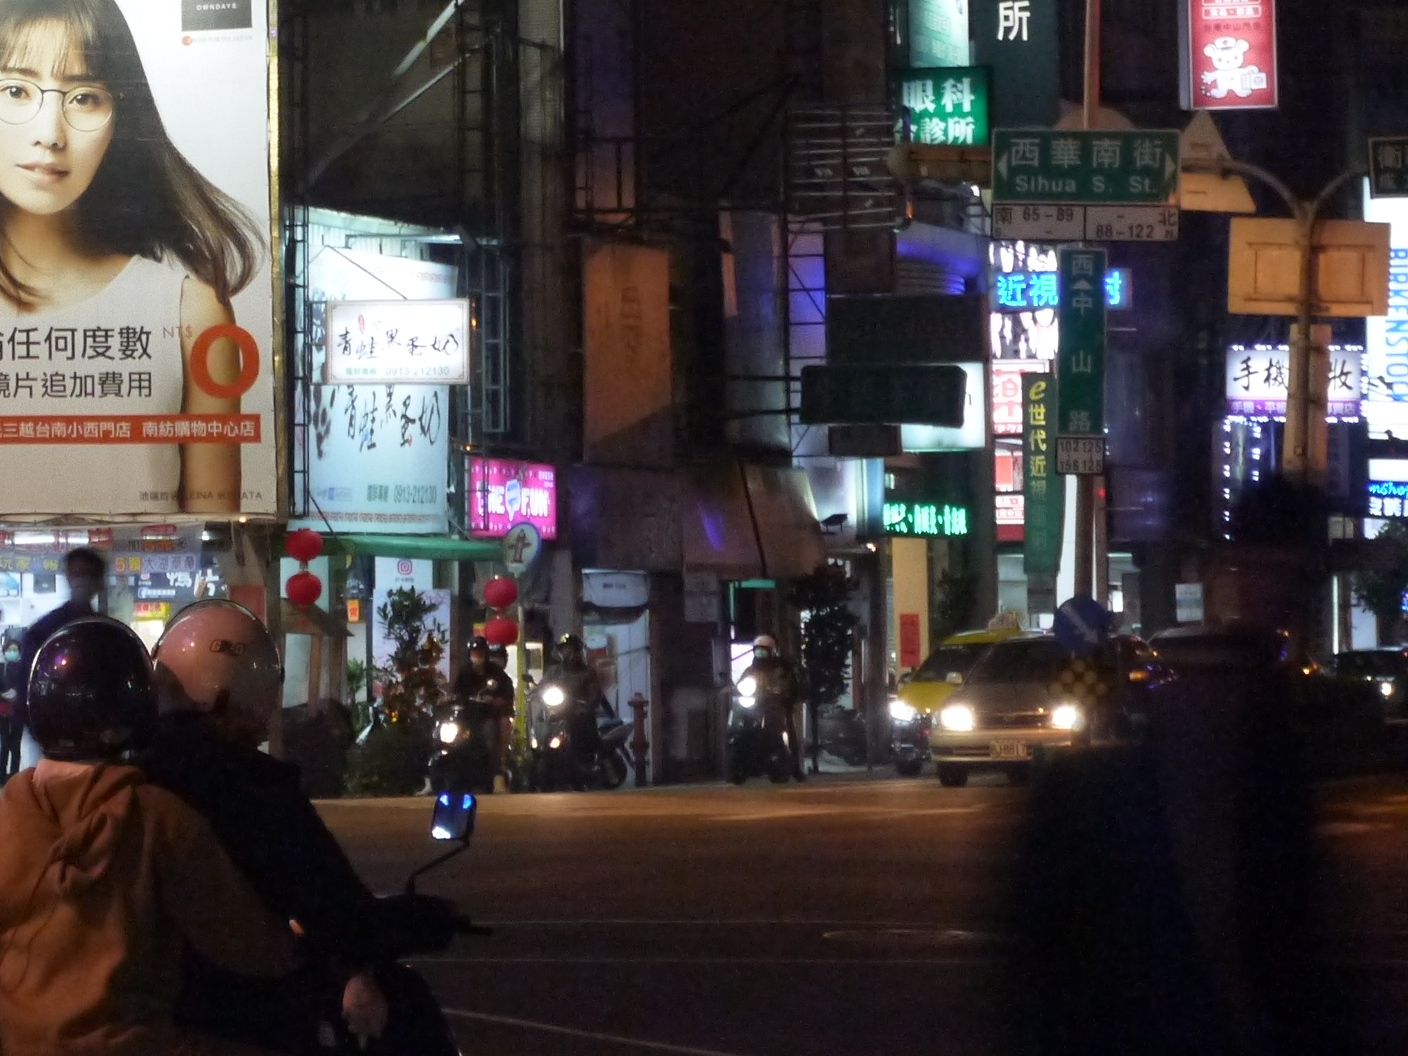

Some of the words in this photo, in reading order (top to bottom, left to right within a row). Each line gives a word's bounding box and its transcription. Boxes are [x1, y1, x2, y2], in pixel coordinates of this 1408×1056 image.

[901, 77, 976, 114] 眼科
[1010, 138, 1162, 169] 西華南街
[1015, 176, 1077, 193] Sihua
[1128, 176, 1158, 193] St.
[1233, 355, 1353, 392] 手機收
